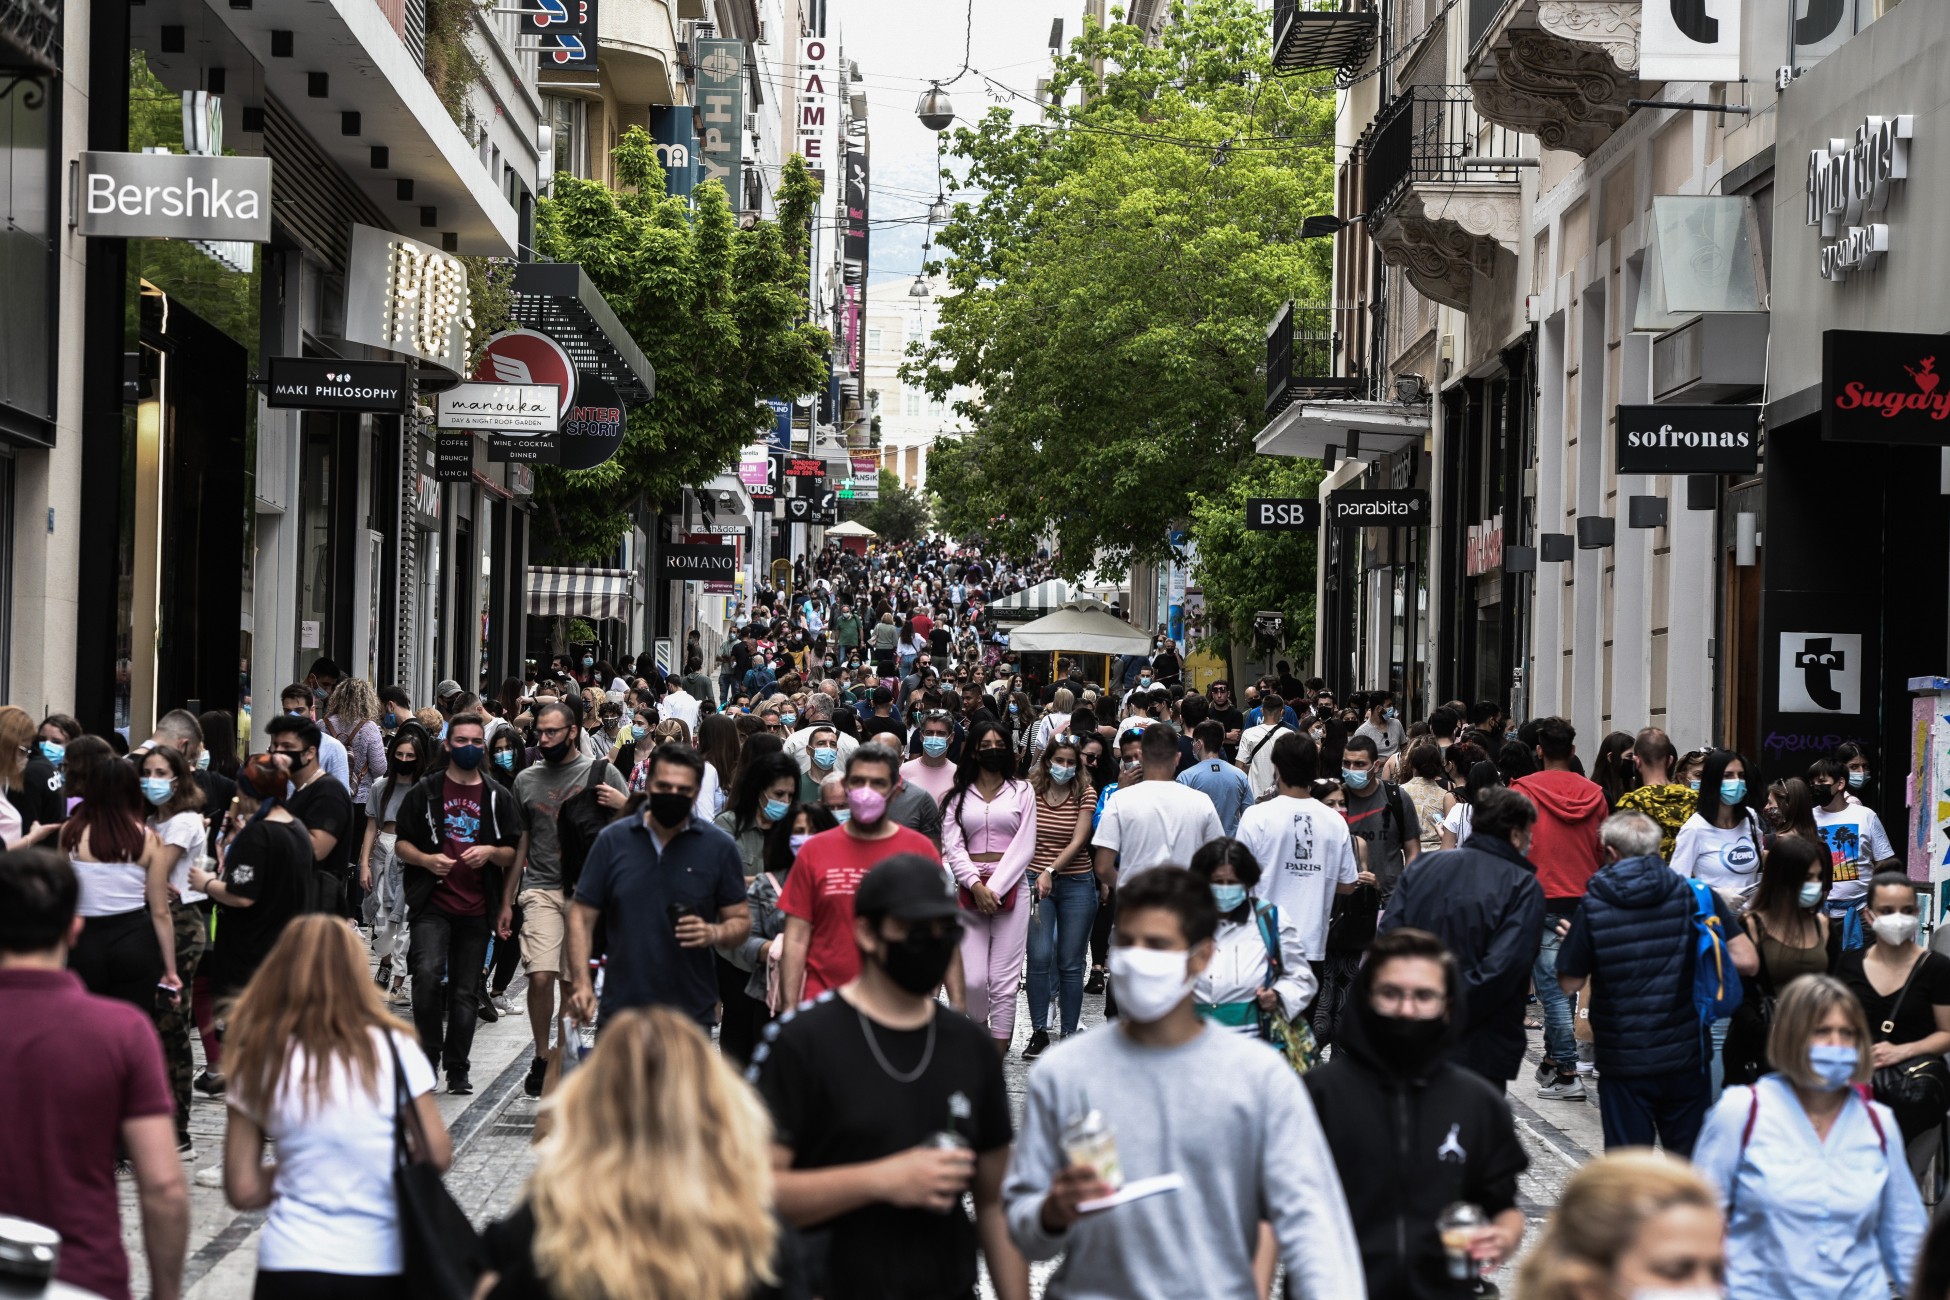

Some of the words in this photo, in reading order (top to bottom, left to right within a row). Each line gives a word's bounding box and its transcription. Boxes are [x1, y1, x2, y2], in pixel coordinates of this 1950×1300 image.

[88, 173, 259, 220] Bershka
[275, 385, 308, 395] MAKI
[315, 386, 398, 399] PHILOSOPHY
[452, 388, 546, 414] manouka
[567, 421, 620, 437] SPORT
[1628, 424, 1750, 448] sofronas
[1261, 504, 1305, 524] BSB
[1337, 501, 1409, 518] parabita
[696, 525, 739, 533] dah&dot.
[666, 555, 733, 570] ROMANO
[1362, 831, 1375, 841] DO
[1379, 830, 1388, 840] IT
[1731, 850, 1754, 861] Zewa
[1285, 862, 1322, 871] PARIS
